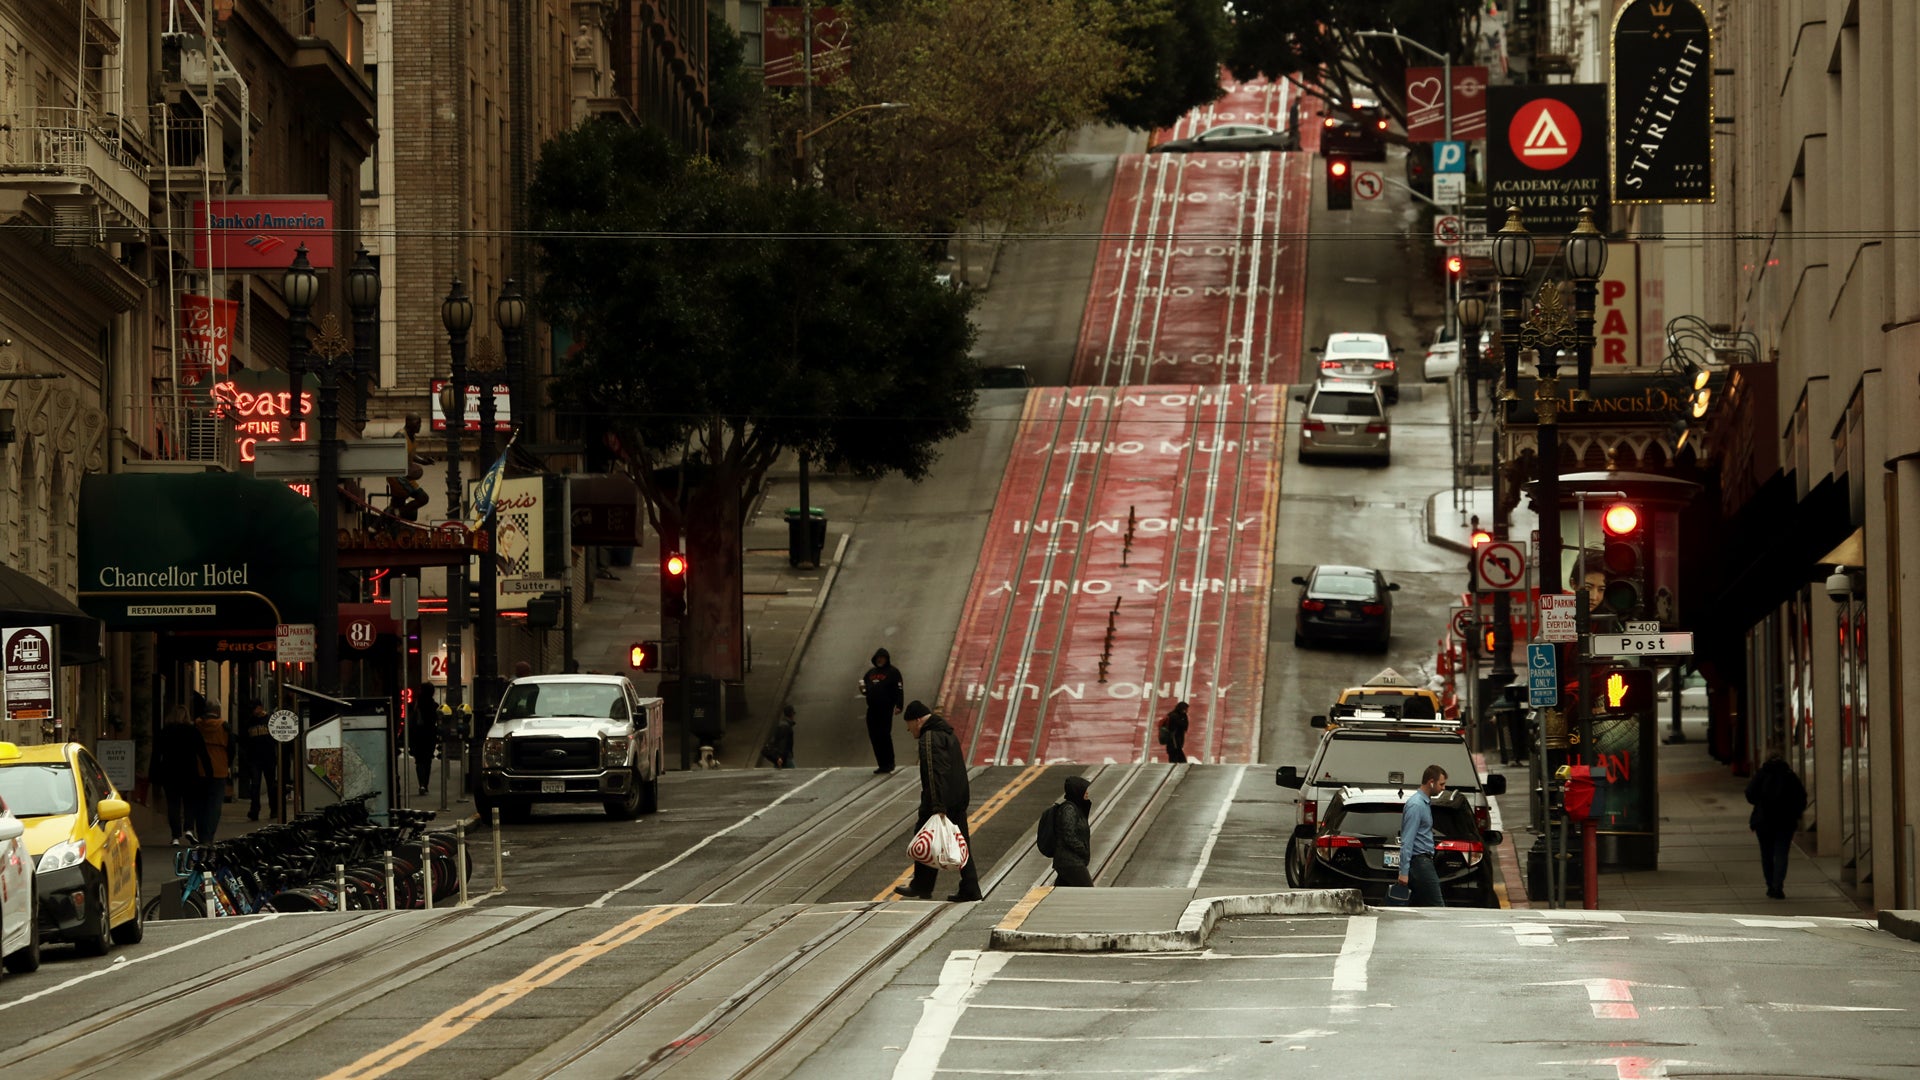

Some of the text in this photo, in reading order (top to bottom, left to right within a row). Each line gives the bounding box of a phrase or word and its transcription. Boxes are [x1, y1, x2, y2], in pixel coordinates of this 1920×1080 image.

[1625, 66, 1667, 147] LIZZIE'S
[1624, 39, 1704, 190] STARLIGHT
[1493, 179, 1561, 192] ACADEMY
[1572, 178, 1599, 190] ART
[1493, 194, 1600, 208] UNIVERSITY
[210, 212, 325, 228] Bank of America
[209, 381, 312, 418] Sears
[248, 421, 280, 434] FINE
[1012, 519, 1120, 534] MUNI
[1137, 516, 1256, 532] ONLY
[99, 562, 249, 588] Chancellor Hotel
[514, 581, 550, 591] Sutter
[988, 579, 1113, 596] ONLY
[1136, 577, 1249, 594] MUNI
[1542, 596, 1552, 609] NO
[131, 606, 212, 615] RESTAURANT & BAR
[277, 625, 313, 637] NO PARKING
[350, 623, 372, 641] 81
[1546, 621, 1575, 629] EVERYDAY
[1638, 623, 1658, 632] 400
[216, 639, 255, 653] Sears
[1621, 637, 1666, 650] Post
[1530, 668, 1555, 678] PARKING
[1106, 680, 1239, 699] ONLY
[1535, 678, 1551, 688] ONLY
[965, 682, 1086, 701] MUNI
